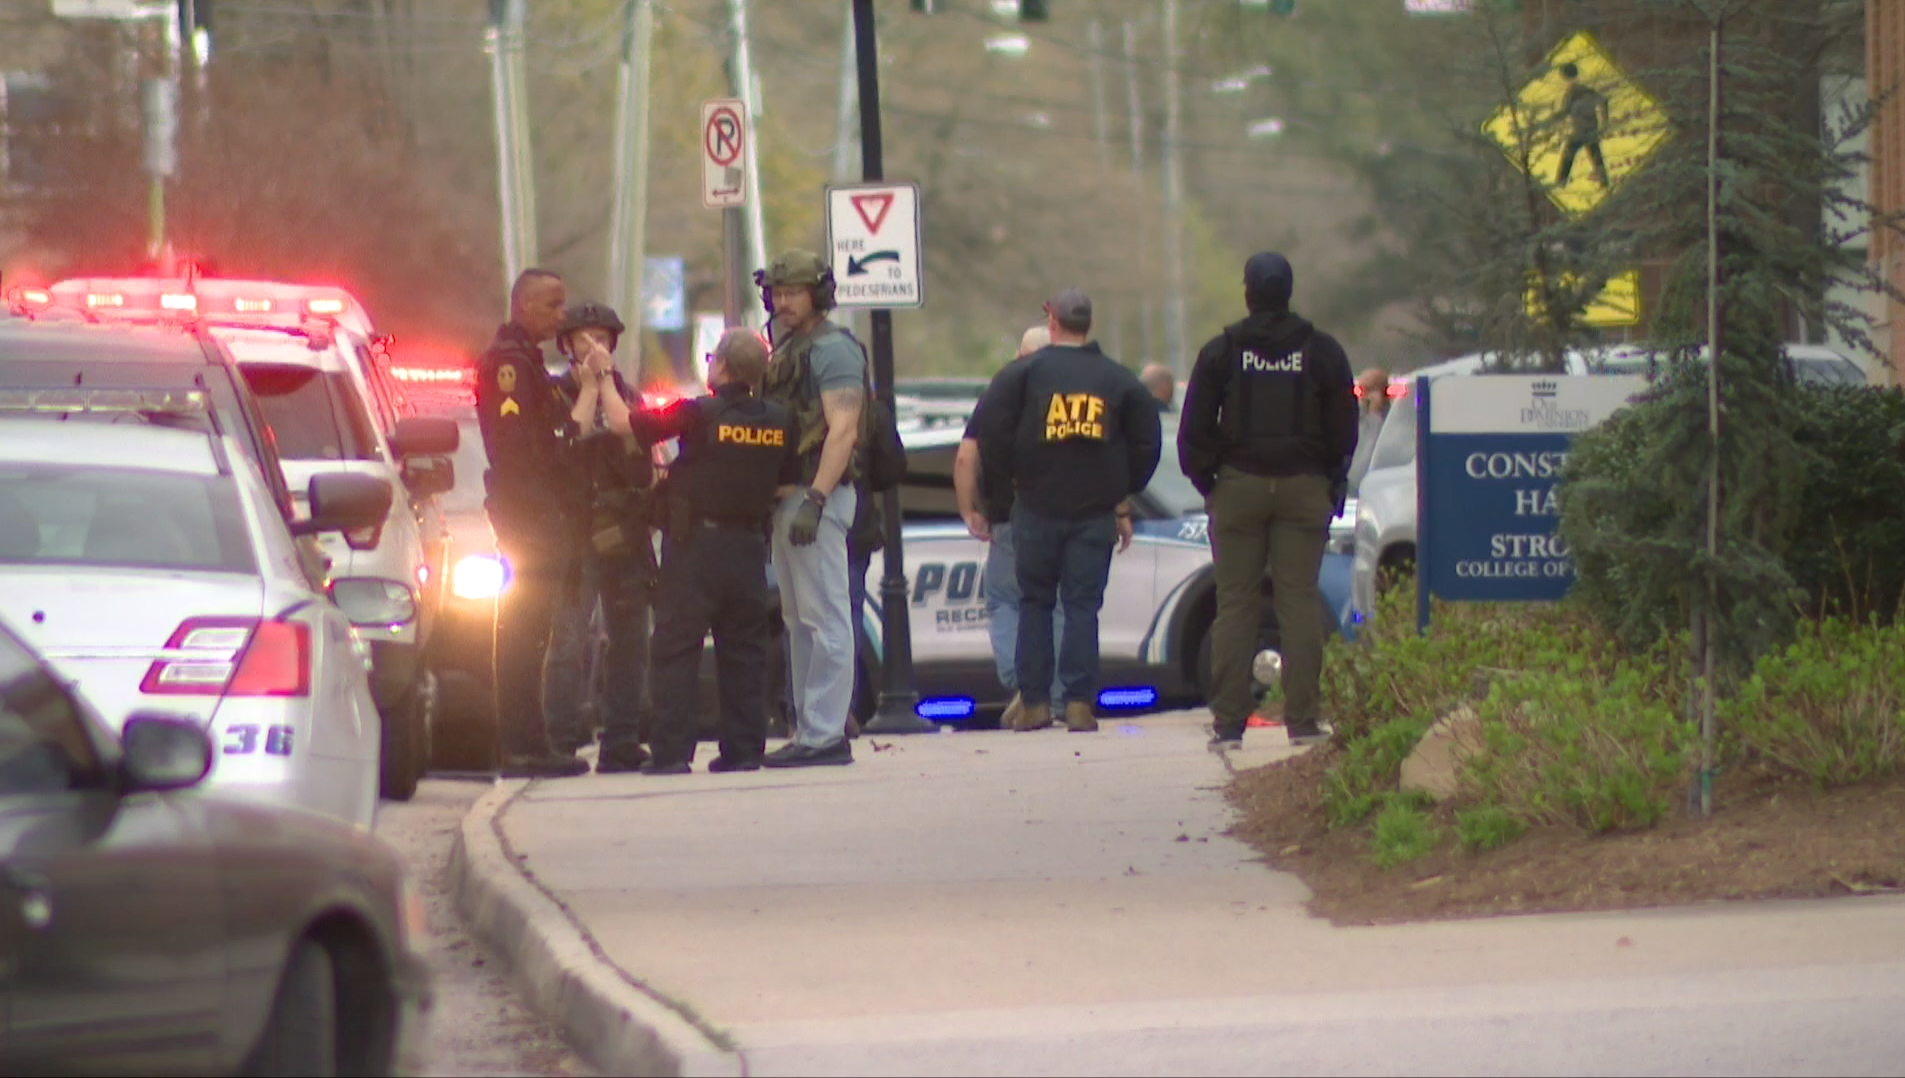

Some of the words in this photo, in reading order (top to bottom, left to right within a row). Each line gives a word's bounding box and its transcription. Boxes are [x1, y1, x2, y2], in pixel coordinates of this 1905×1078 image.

[837, 240, 866, 251] HERE
[887, 267, 901, 279] TO
[838, 283, 914, 298] PEDESTRIANS
[1242, 350, 1303, 372] POLICE
[1046, 392, 1105, 424] ATF
[718, 424, 784, 447] POLICE
[1045, 421, 1103, 440] POLICE
[1465, 452, 1569, 478] CONST
[1514, 488, 1558, 515] HA
[1491, 534, 1570, 558] STRO
[1456, 561, 1538, 577] COLLEGE
[1543, 561, 1568, 577] OF
[911, 562, 985, 606] PO
[936, 609, 992, 624] RECR
[223, 724, 295, 757] 36
